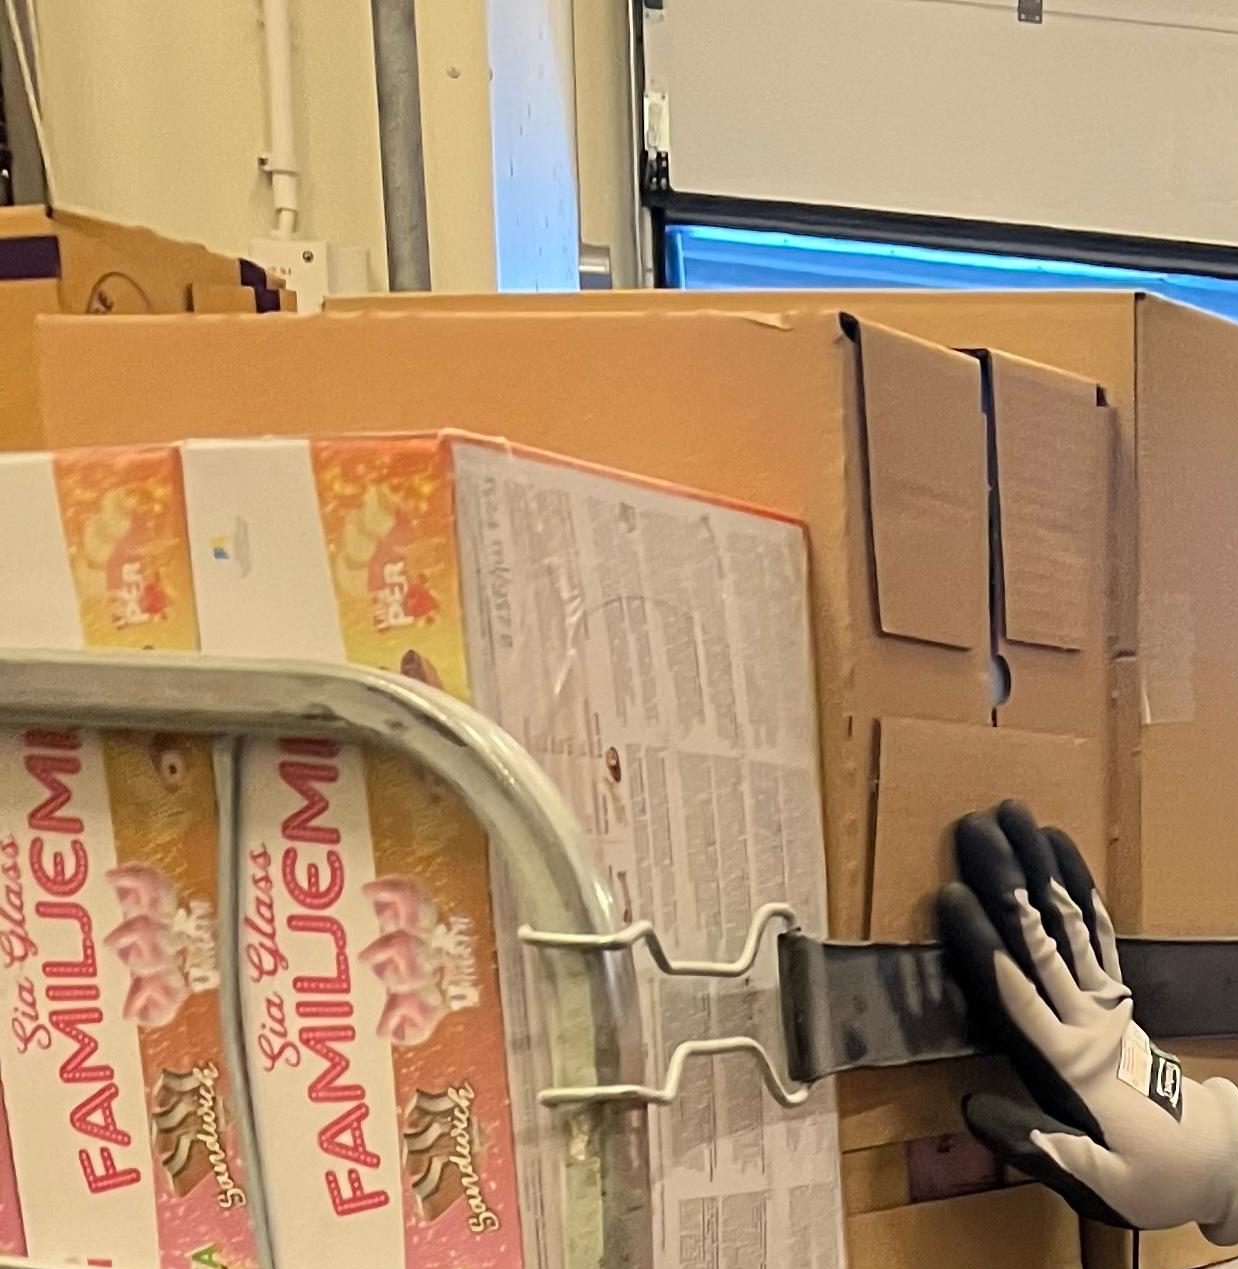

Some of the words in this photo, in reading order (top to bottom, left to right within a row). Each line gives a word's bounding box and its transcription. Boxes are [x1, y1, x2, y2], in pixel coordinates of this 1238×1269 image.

[0, 834, 38, 970] Glass
[25, 724, 142, 1193] FAMILJEMI
[244, 842, 292, 983] Glass
[11, 977, 51, 1054] Sia
[259, 993, 302, 1072] Sia
[278, 738, 390, 1217] FAMILJEMI
[191, 1061, 248, 1210] Sandwich
[444, 1081, 501, 1235] Sandwich
